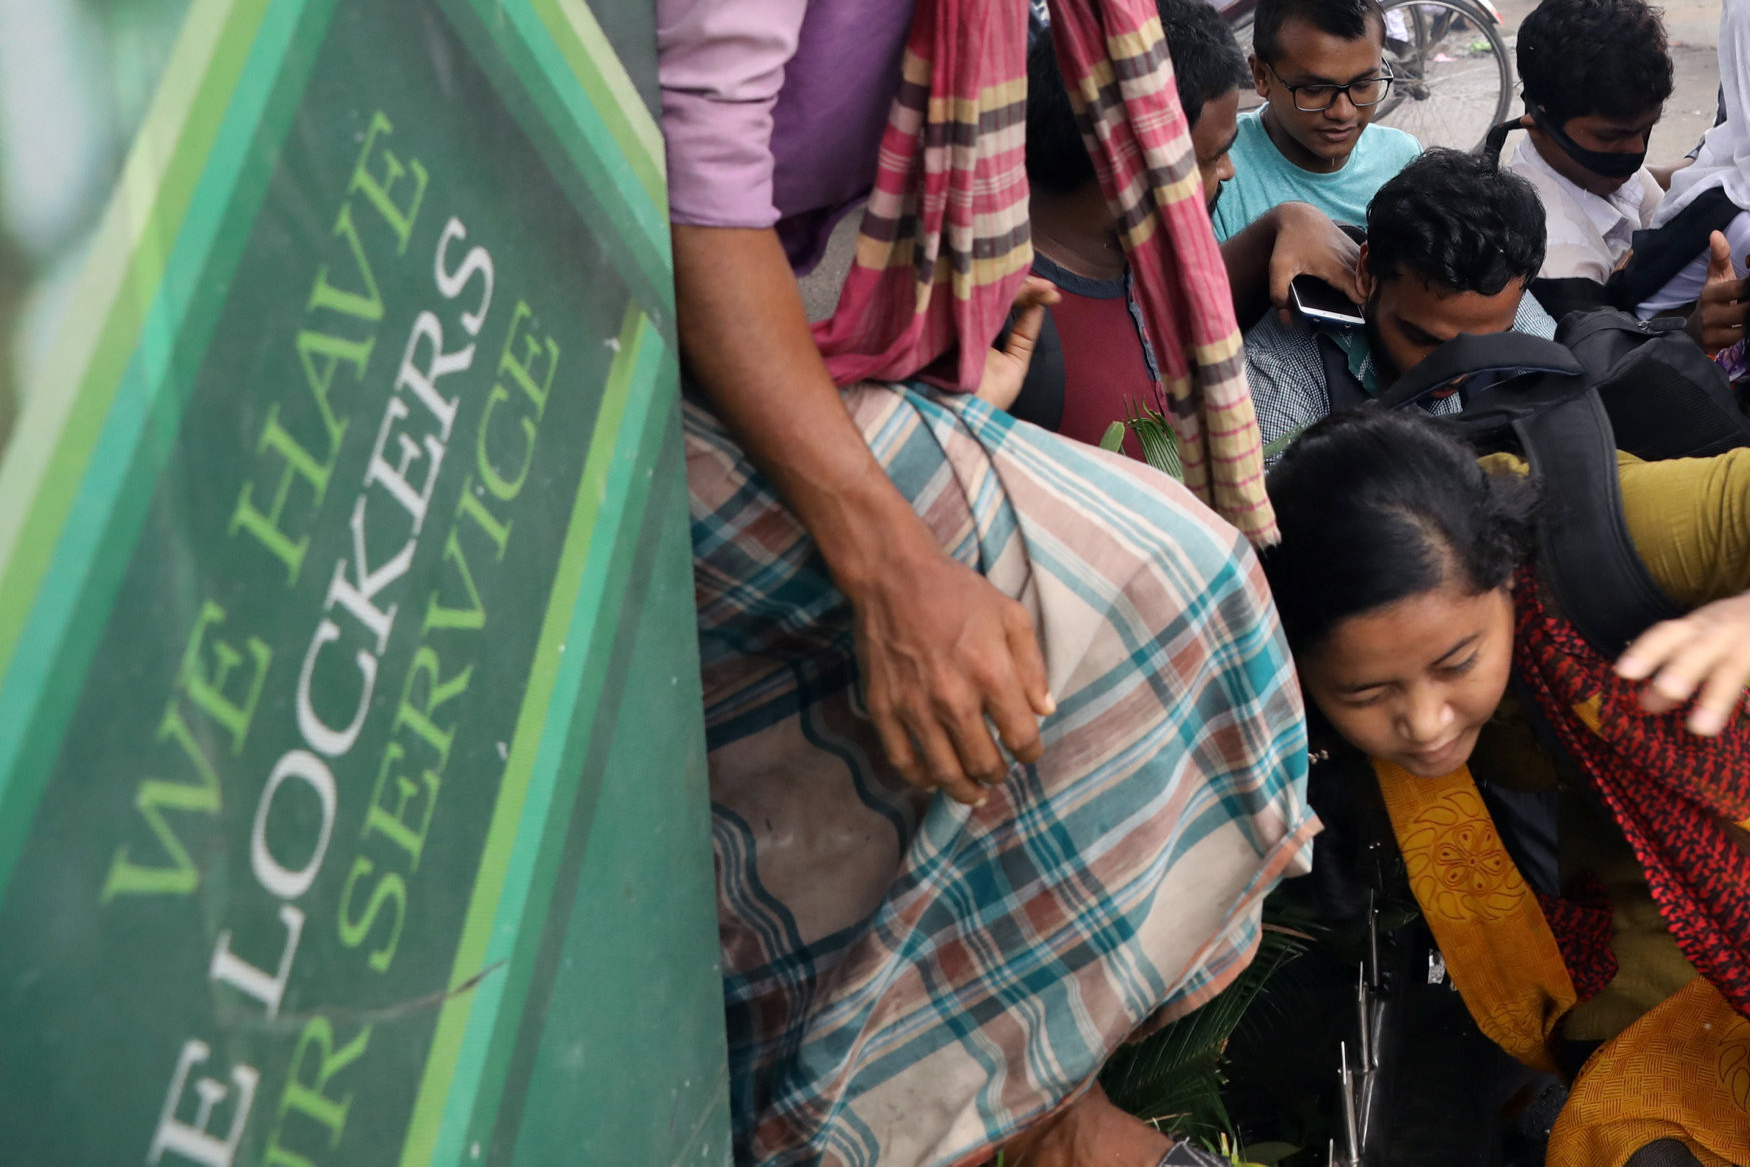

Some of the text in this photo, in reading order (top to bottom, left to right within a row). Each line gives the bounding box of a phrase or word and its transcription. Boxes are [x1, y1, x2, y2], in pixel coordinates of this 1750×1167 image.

[101, 110, 429, 906] WE HAVE
[208, 216, 495, 1022] LOCKERS
[337, 299, 560, 974] SERVICE
